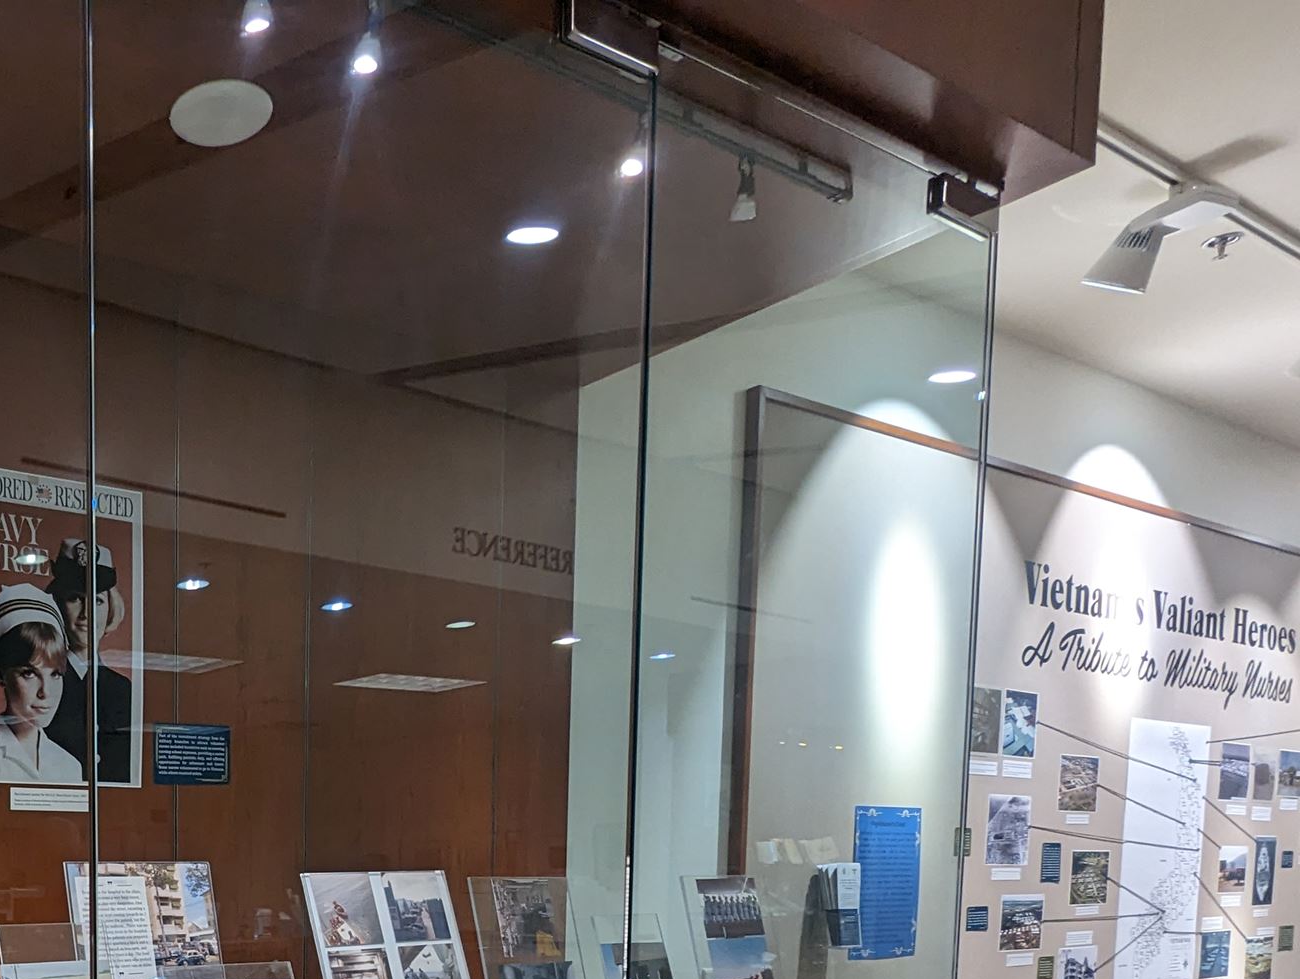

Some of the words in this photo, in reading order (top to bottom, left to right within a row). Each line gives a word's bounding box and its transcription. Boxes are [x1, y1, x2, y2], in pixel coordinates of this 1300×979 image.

[55, 485, 133, 517] RESCTED
[1025, 560, 1144, 625] Vietnas
[1153, 590, 1225, 641] Valiant
[1232, 608, 1296, 654] Heroes
[1022, 621, 1056, 667] A
[1059, 628, 1131, 676] Tribute
[1138, 650, 1158, 681] to
[1164, 649, 1238, 710] Military
[1242, 659, 1293, 703] Nurses
